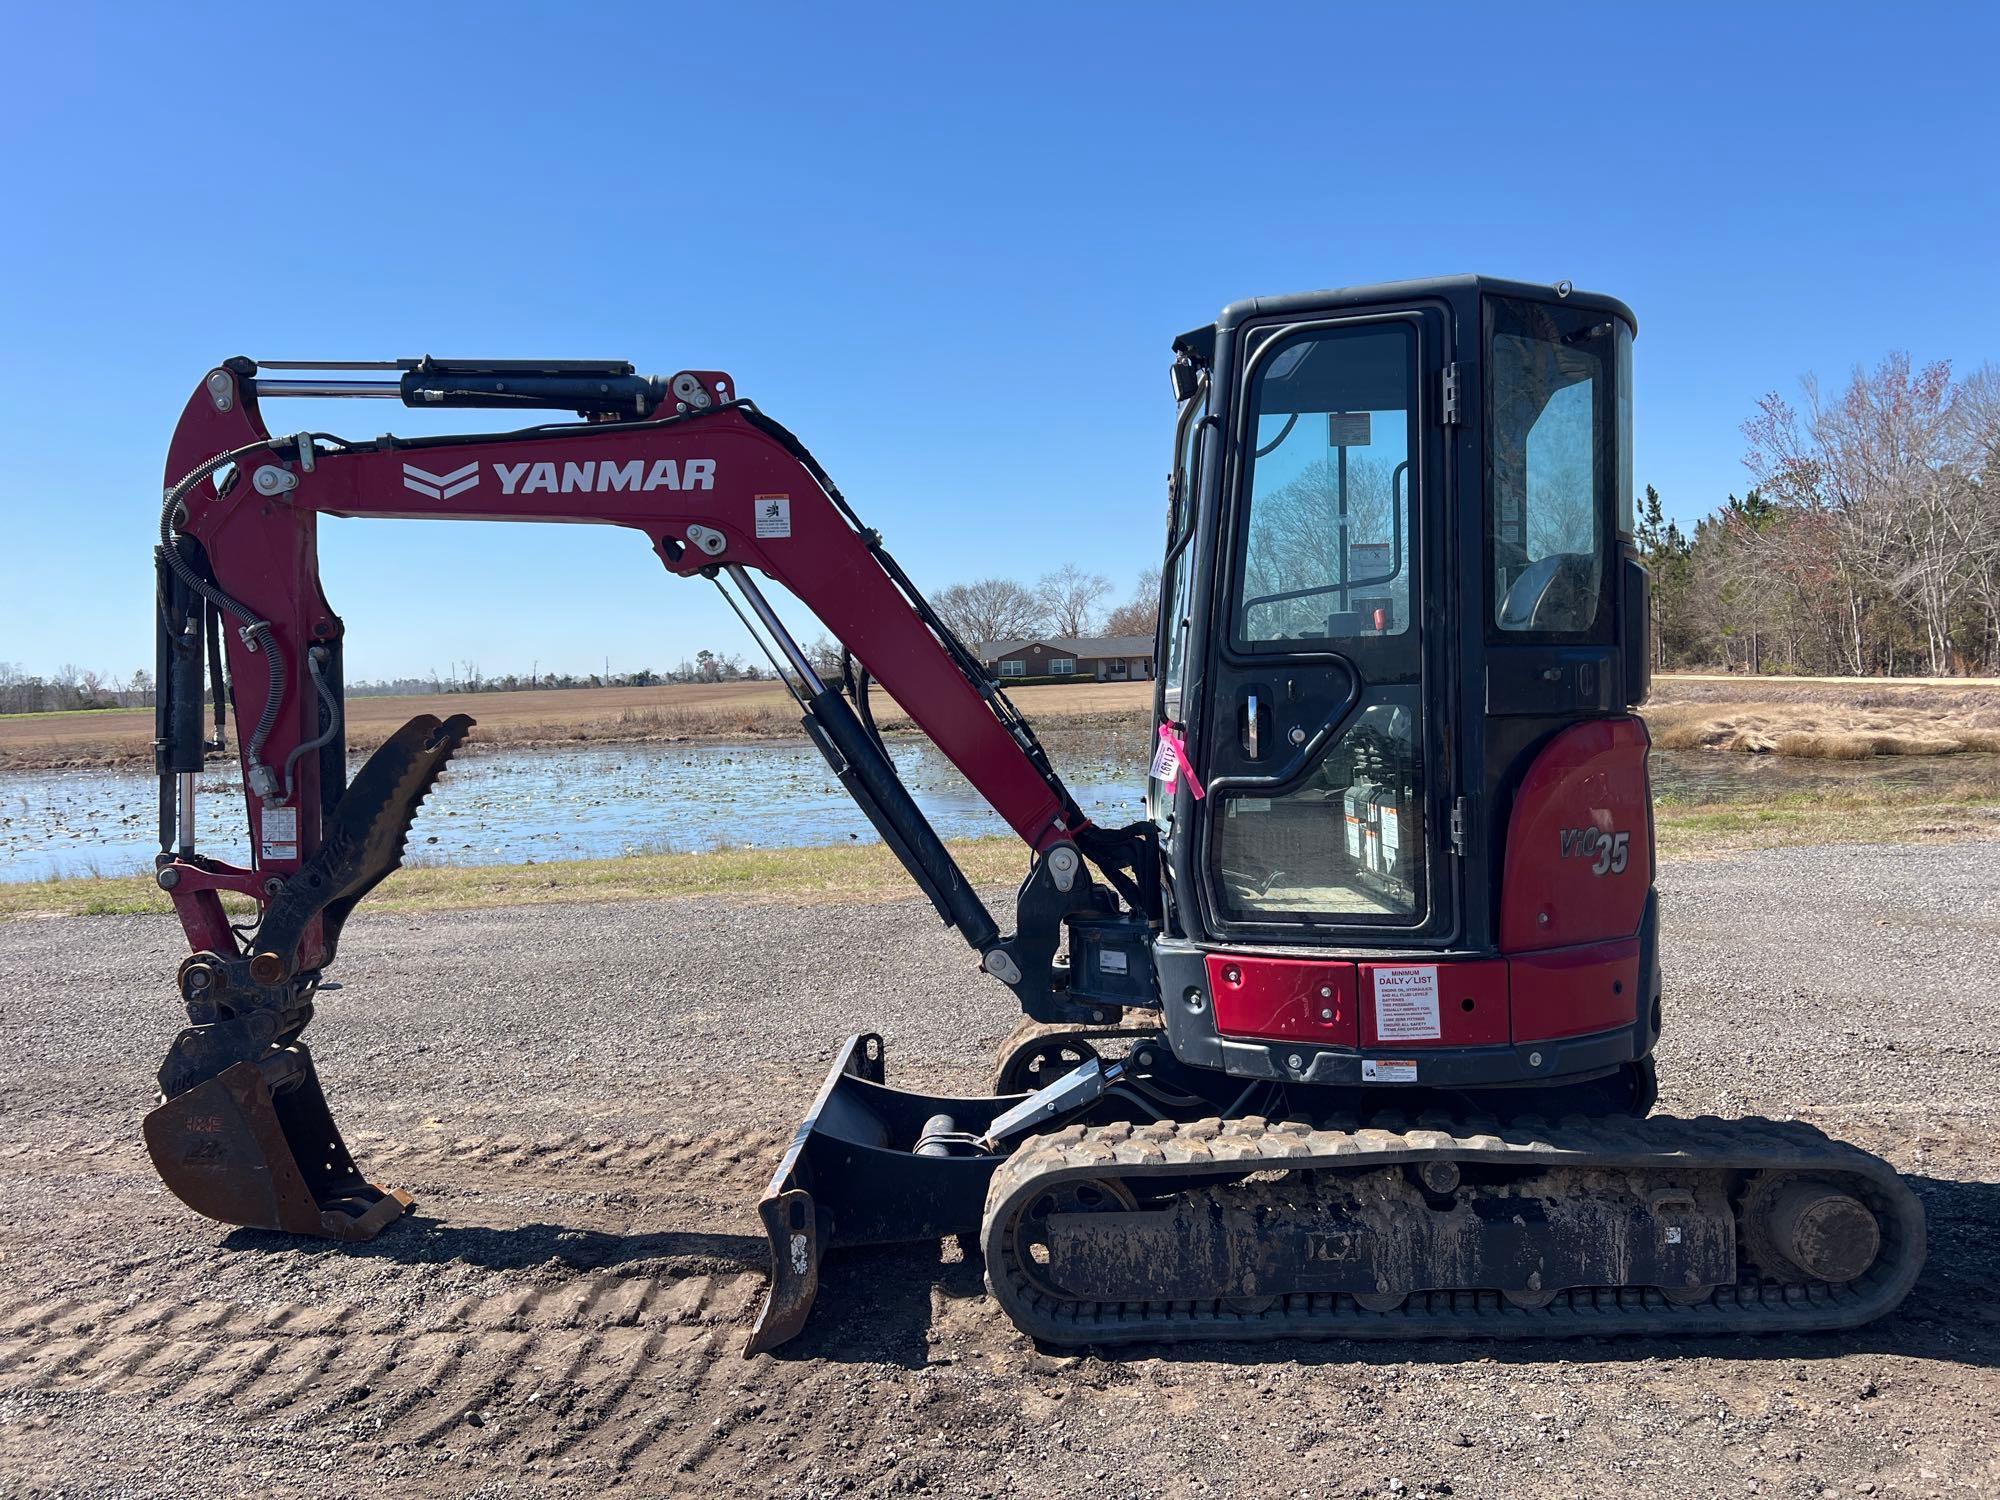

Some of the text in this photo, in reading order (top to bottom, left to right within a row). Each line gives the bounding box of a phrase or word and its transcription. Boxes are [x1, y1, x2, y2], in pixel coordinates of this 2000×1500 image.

[493, 459, 716, 494] YANMAR
[1380, 976, 1432, 985] DAILY LIST
